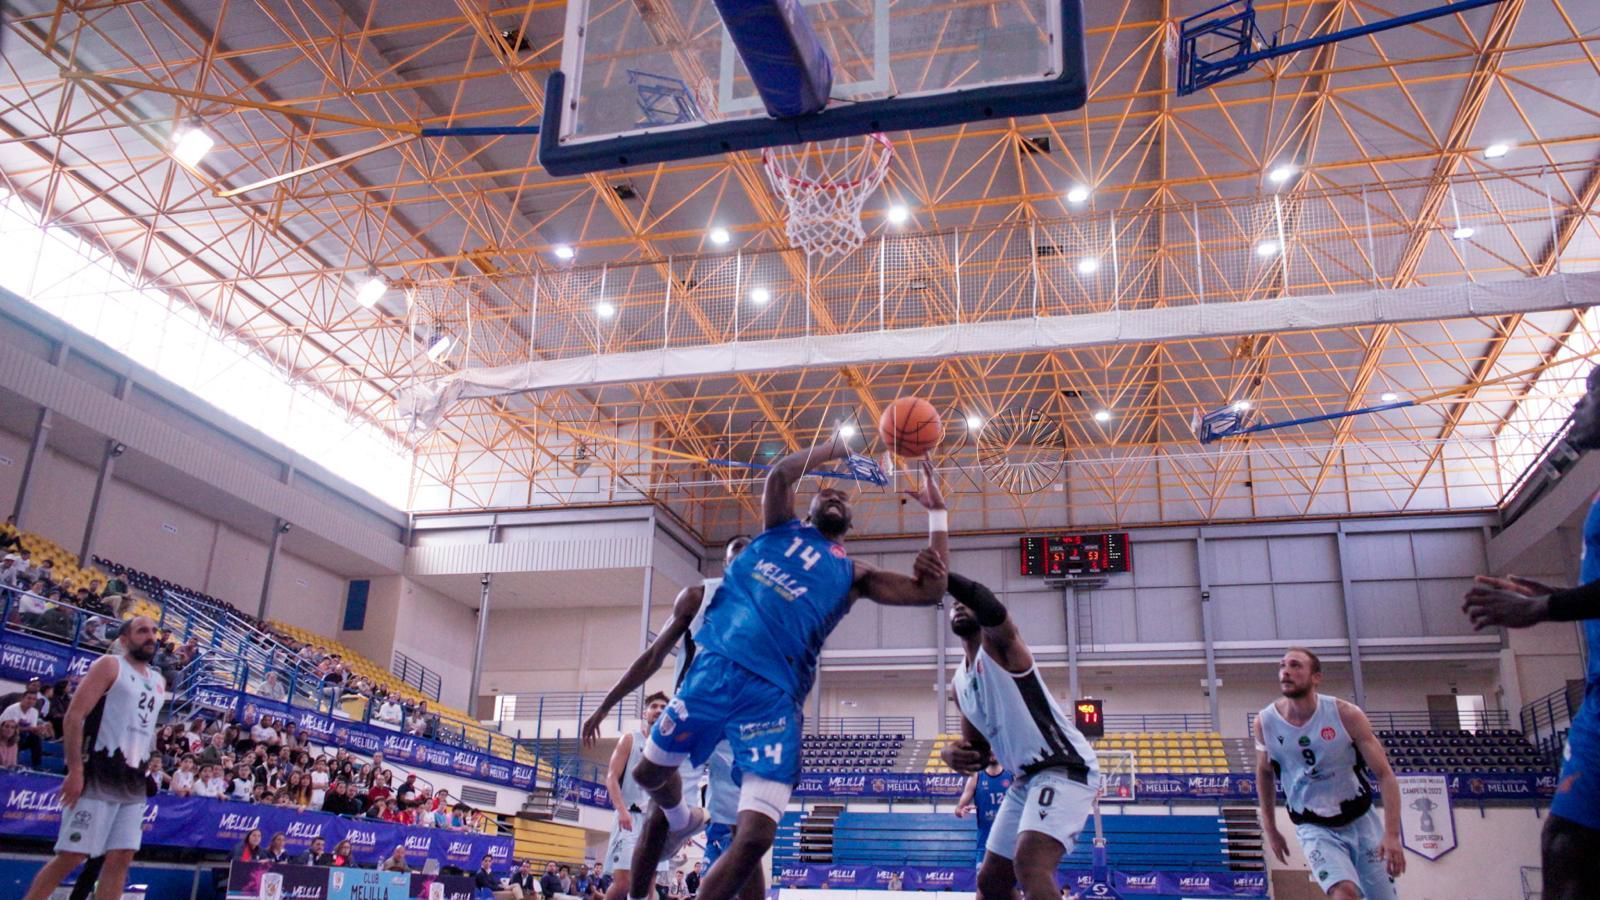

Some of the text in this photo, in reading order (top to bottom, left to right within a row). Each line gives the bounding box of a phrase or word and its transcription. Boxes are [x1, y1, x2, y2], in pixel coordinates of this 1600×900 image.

[784, 536, 821, 571] 14
[753, 559, 808, 598] MELILLA
[1, 652, 55, 677] MELILLA
[138, 691, 155, 712] 24
[300, 713, 336, 734] MELILLA
[350, 735, 379, 750] MELILLA
[384, 735, 413, 752] MELILLA
[453, 751, 479, 767] MELILLA
[748, 743, 783, 764] 14
[1302, 748, 1316, 766] 9
[828, 775, 866, 787] MELILLA
[887, 783, 920, 791] MELILLA
[926, 776, 964, 787] MELILLA
[1188, 776, 1230, 788] MELILLA
[1146, 784, 1182, 793] MELILLA
[1488, 784, 1529, 793] MELILLA
[1038, 786, 1055, 807] 0
[219, 813, 261, 831] MELILLA
[286, 821, 322, 838] MELILLA
[345, 828, 376, 845] MELILLA
[404, 835, 432, 850] MELILLA
[447, 841, 472, 855] MELILLA
[363, 872, 380, 883] CLUB
[781, 868, 809, 877] MELILLA
[828, 869, 856, 878] MELILLA
[925, 871, 955, 880] MELILLA
[1126, 876, 1157, 885] MELILLA
[1179, 876, 1210, 886] MELILLA
[1233, 877, 1265, 887] MELILLA
[291, 885, 321, 899] MELILLA
[351, 886, 389, 900] MELILLA
